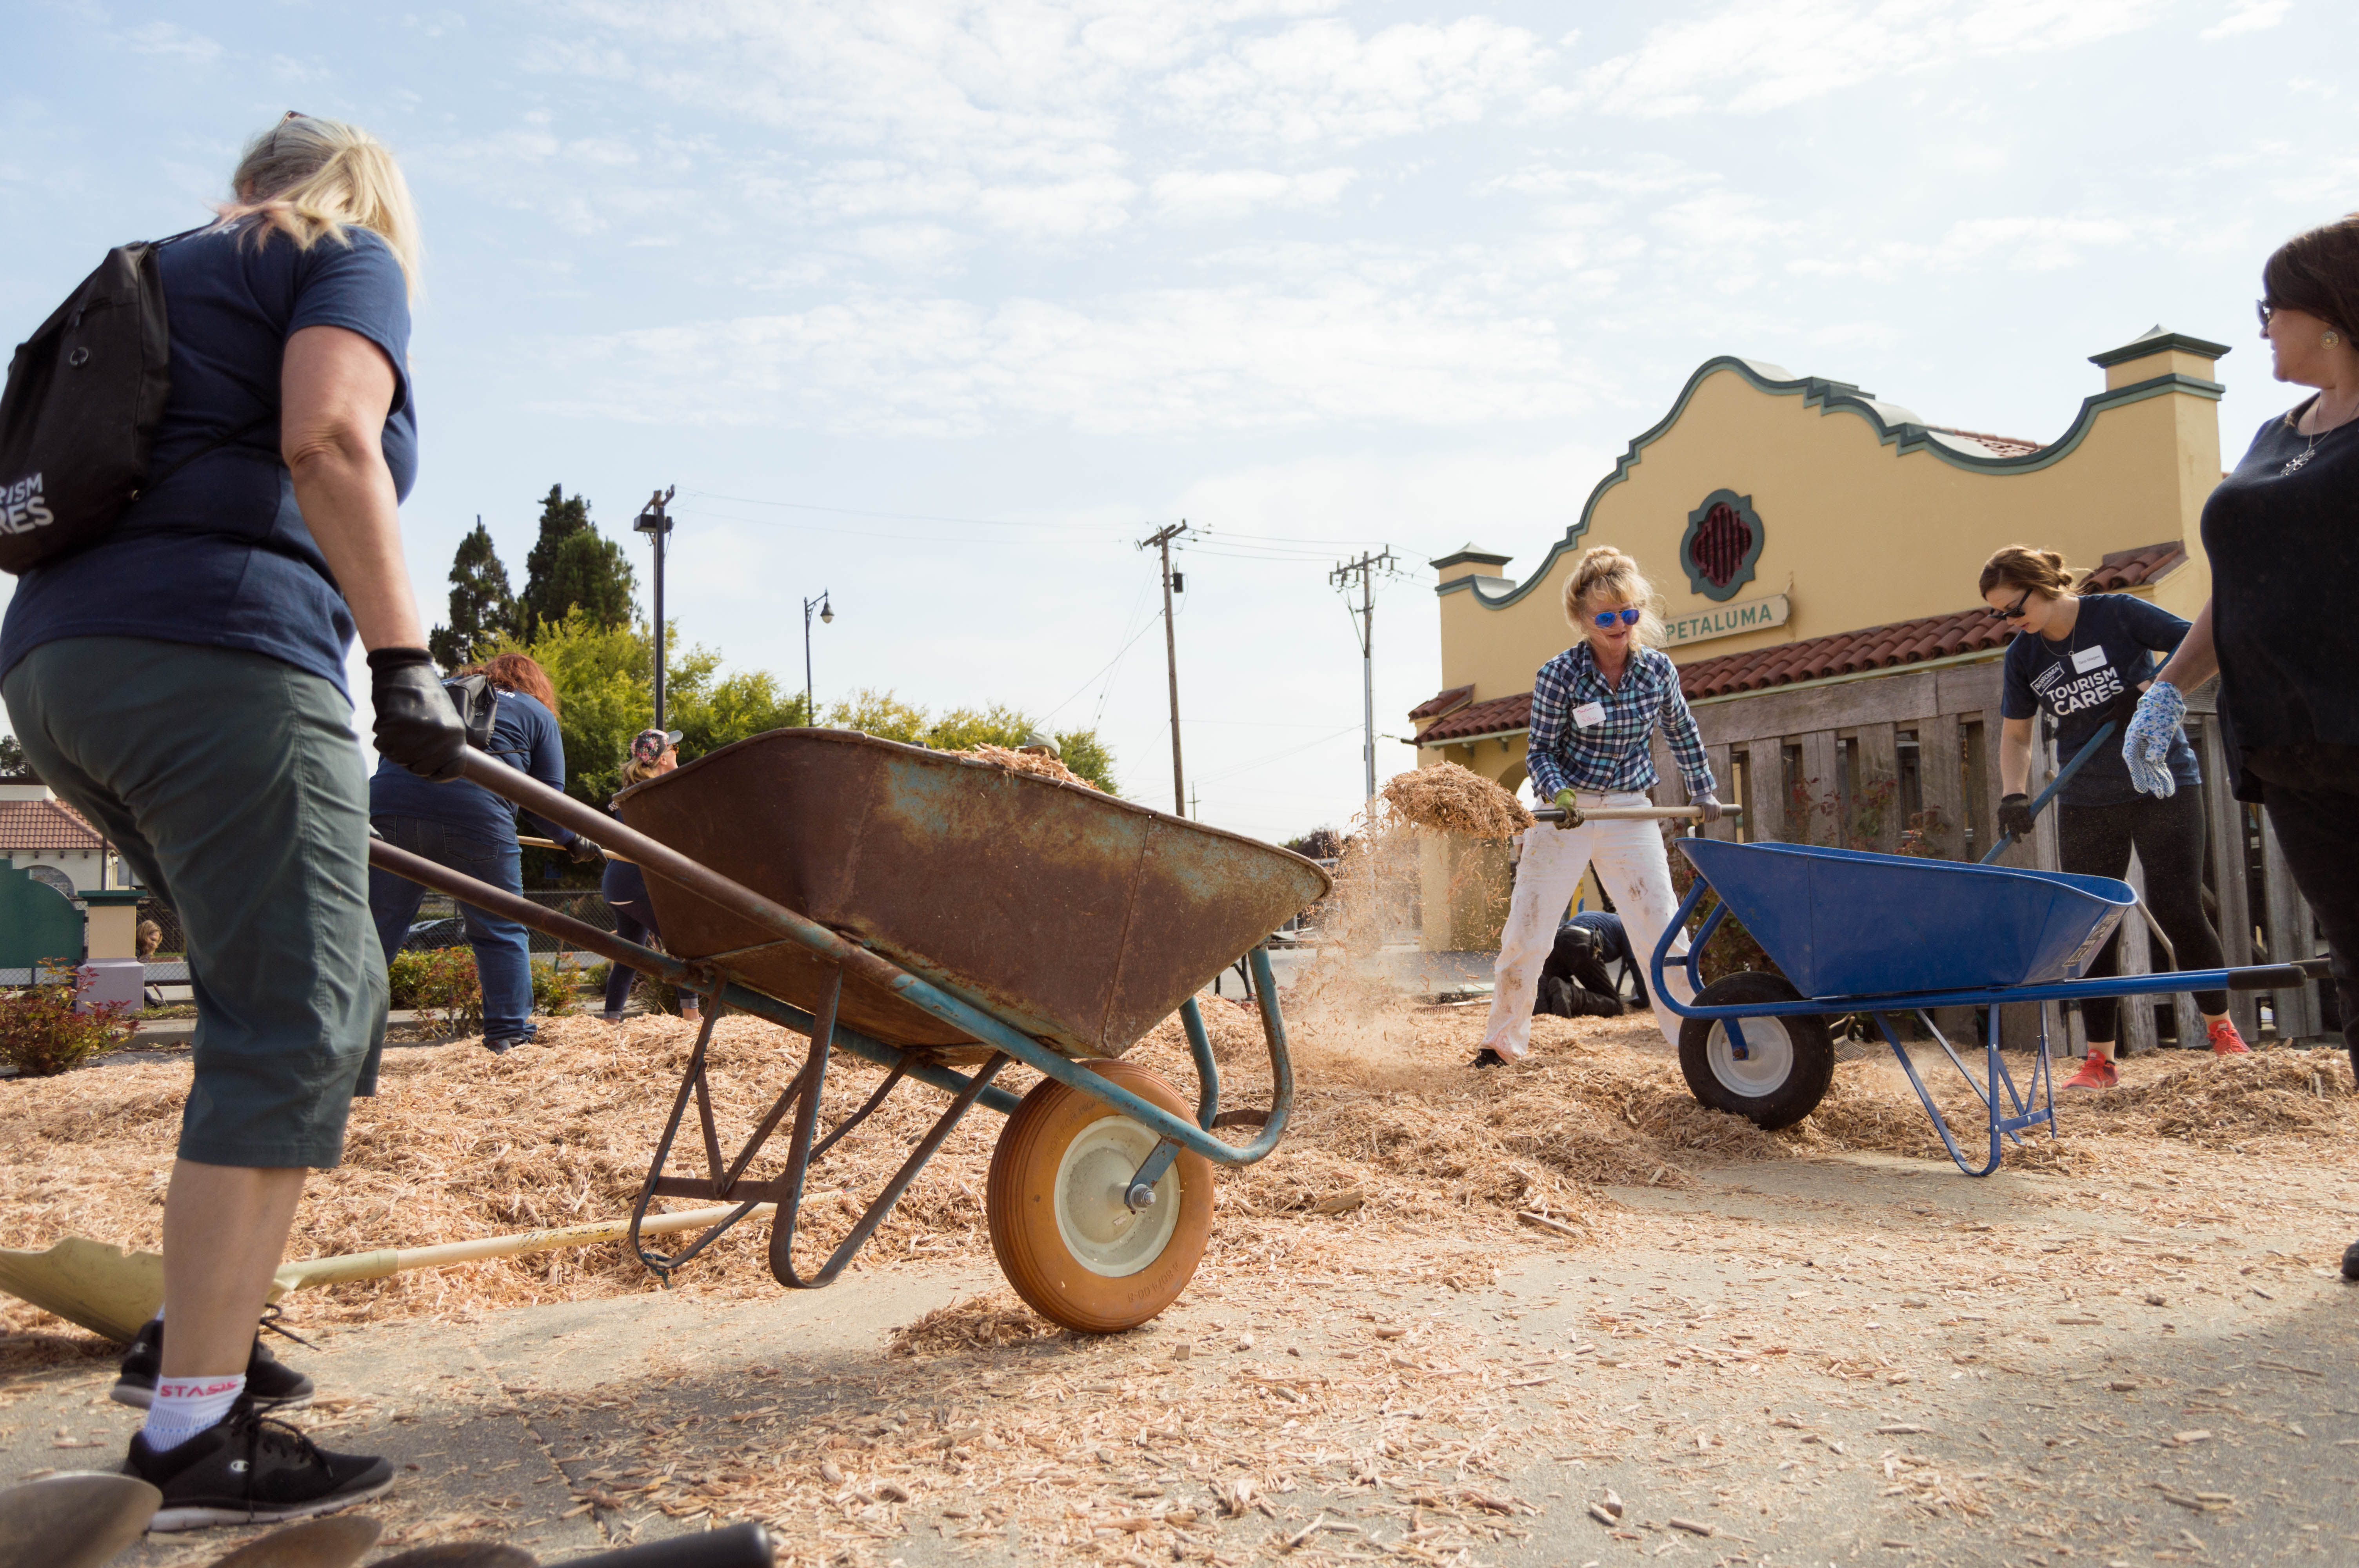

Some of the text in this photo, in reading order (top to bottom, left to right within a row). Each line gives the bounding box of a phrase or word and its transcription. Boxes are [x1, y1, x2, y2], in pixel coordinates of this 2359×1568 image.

[1666, 604, 1773, 641] PETALUMA
[2034, 666, 2059, 690] SONOMA
[2042, 675, 2055, 688] COUNTY
[2046, 666, 2118, 702] TOURISM
[2054, 679, 2125, 715] CARES
